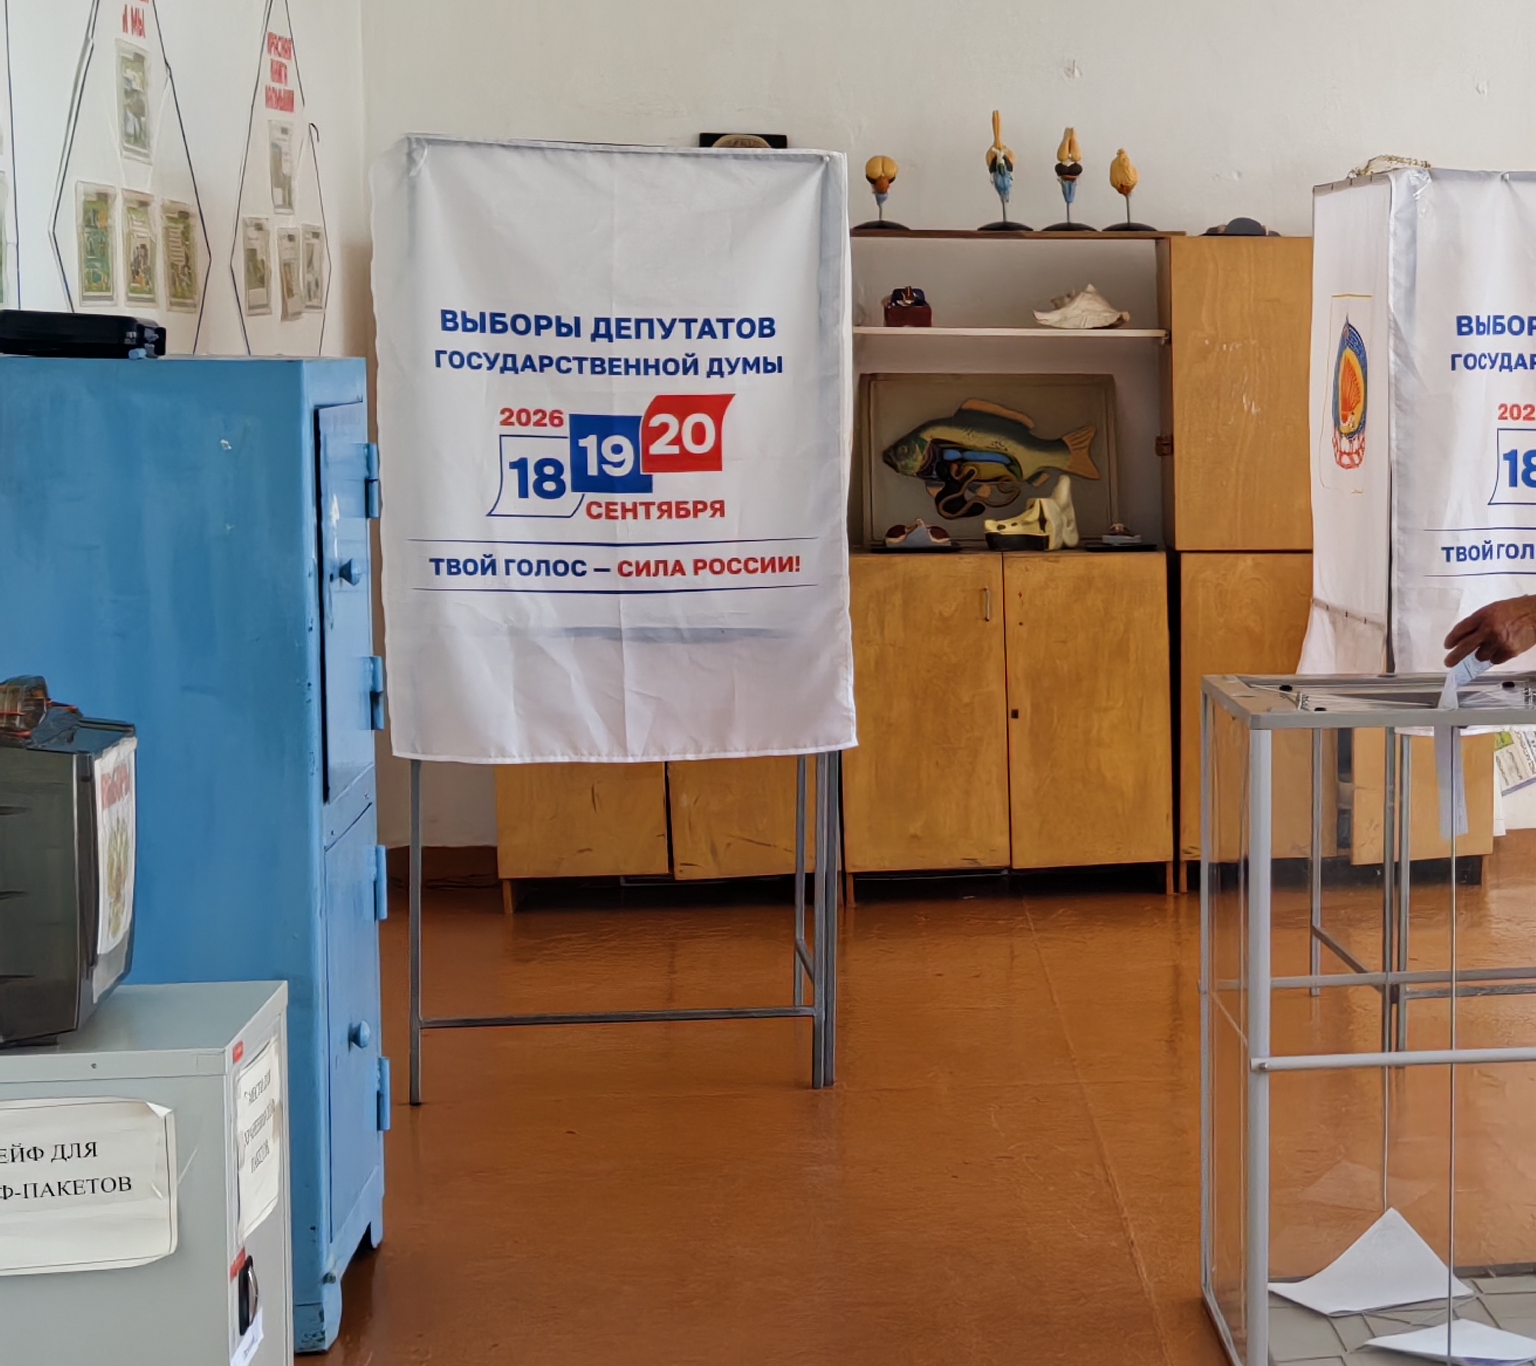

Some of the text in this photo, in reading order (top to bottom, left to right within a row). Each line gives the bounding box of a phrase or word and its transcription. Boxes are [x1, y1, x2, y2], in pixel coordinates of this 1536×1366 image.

[441, 309, 777, 343] ВЫБОРЫ ДЕПУТАТОВ
[435, 349, 783, 377] ГОСУДАРСТВЕННОЙ ДУМЫ
[500, 407, 565, 428] 2026
[509, 413, 716, 500] 18 19 20
[585, 499, 726, 521] СЕНТЯБРЯ
[1441, 540, 1493, 563] ТВОЙ
[429, 553, 498, 577] ТВОЙ
[504, 558, 587, 578] ГОЛОС
[617, 558, 687, 578] СИЛА
[692, 555, 801, 576] РОССИИ!
[50, 1141, 98, 1163] ДЛЯ
